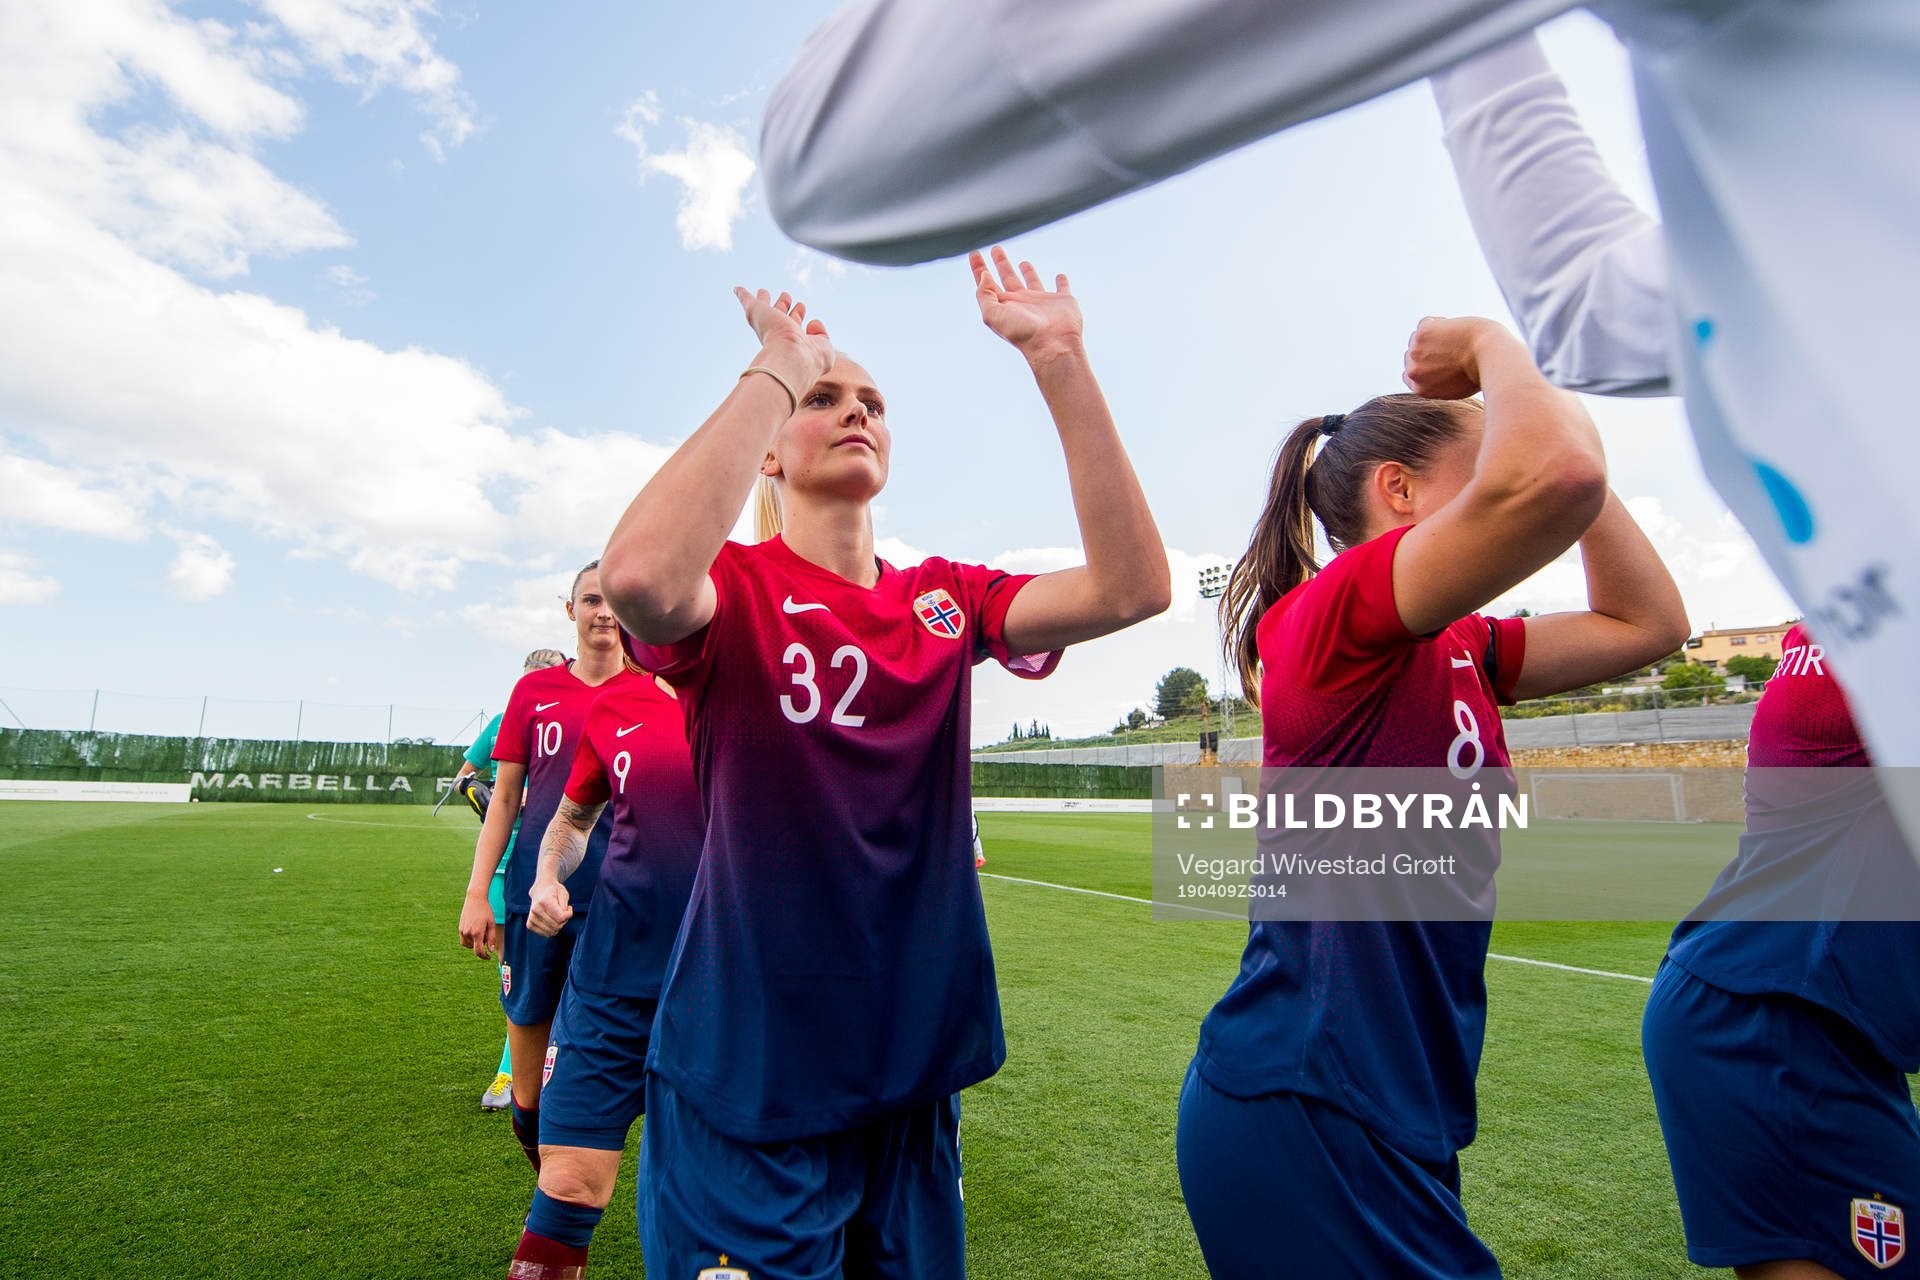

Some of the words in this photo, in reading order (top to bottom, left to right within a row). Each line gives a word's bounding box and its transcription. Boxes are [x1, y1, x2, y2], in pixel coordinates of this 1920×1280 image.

[780, 642, 868, 727] 32
[536, 721, 563, 758] 10
[1447, 700, 1485, 780] 8
[190, 772, 413, 793] MARBELLA
[613, 751, 632, 794] 9
